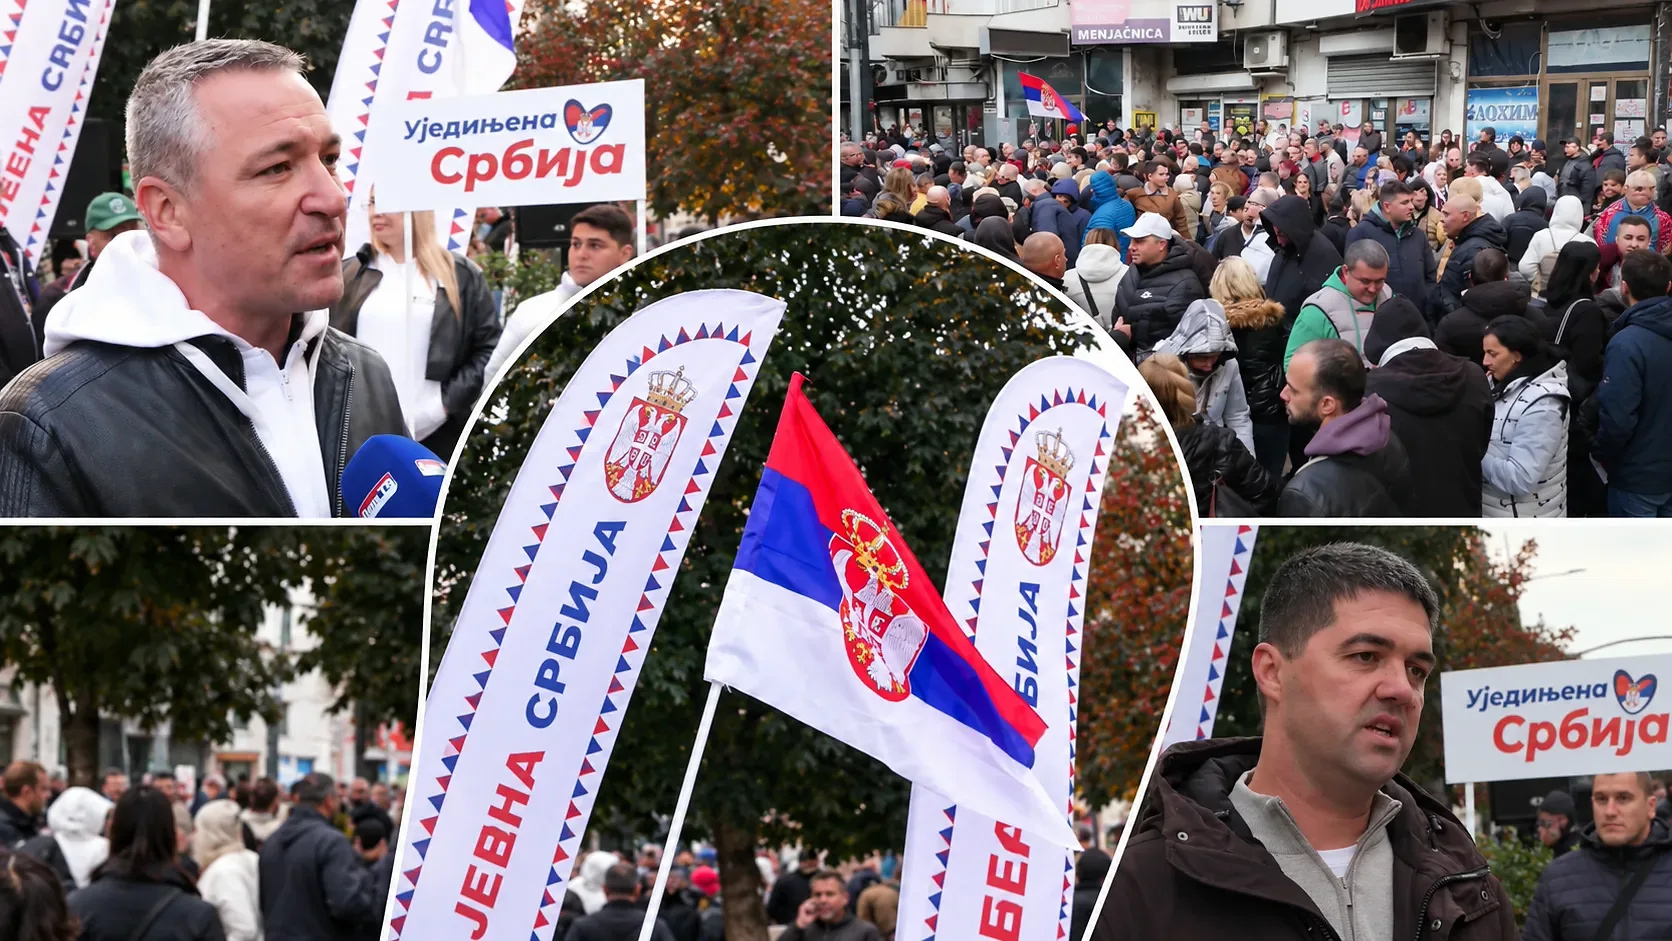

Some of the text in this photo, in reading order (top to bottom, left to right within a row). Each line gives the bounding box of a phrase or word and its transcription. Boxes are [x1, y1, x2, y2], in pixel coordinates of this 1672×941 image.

[1078, 26, 1164, 40] MENJAČNICA
[404, 113, 557, 144] Уједињена
[431, 138, 626, 192] Србија
[526, 520, 627, 729] СРБИЈА
[1467, 682, 1608, 712] Уједињена
[1493, 707, 1670, 762] Србија
